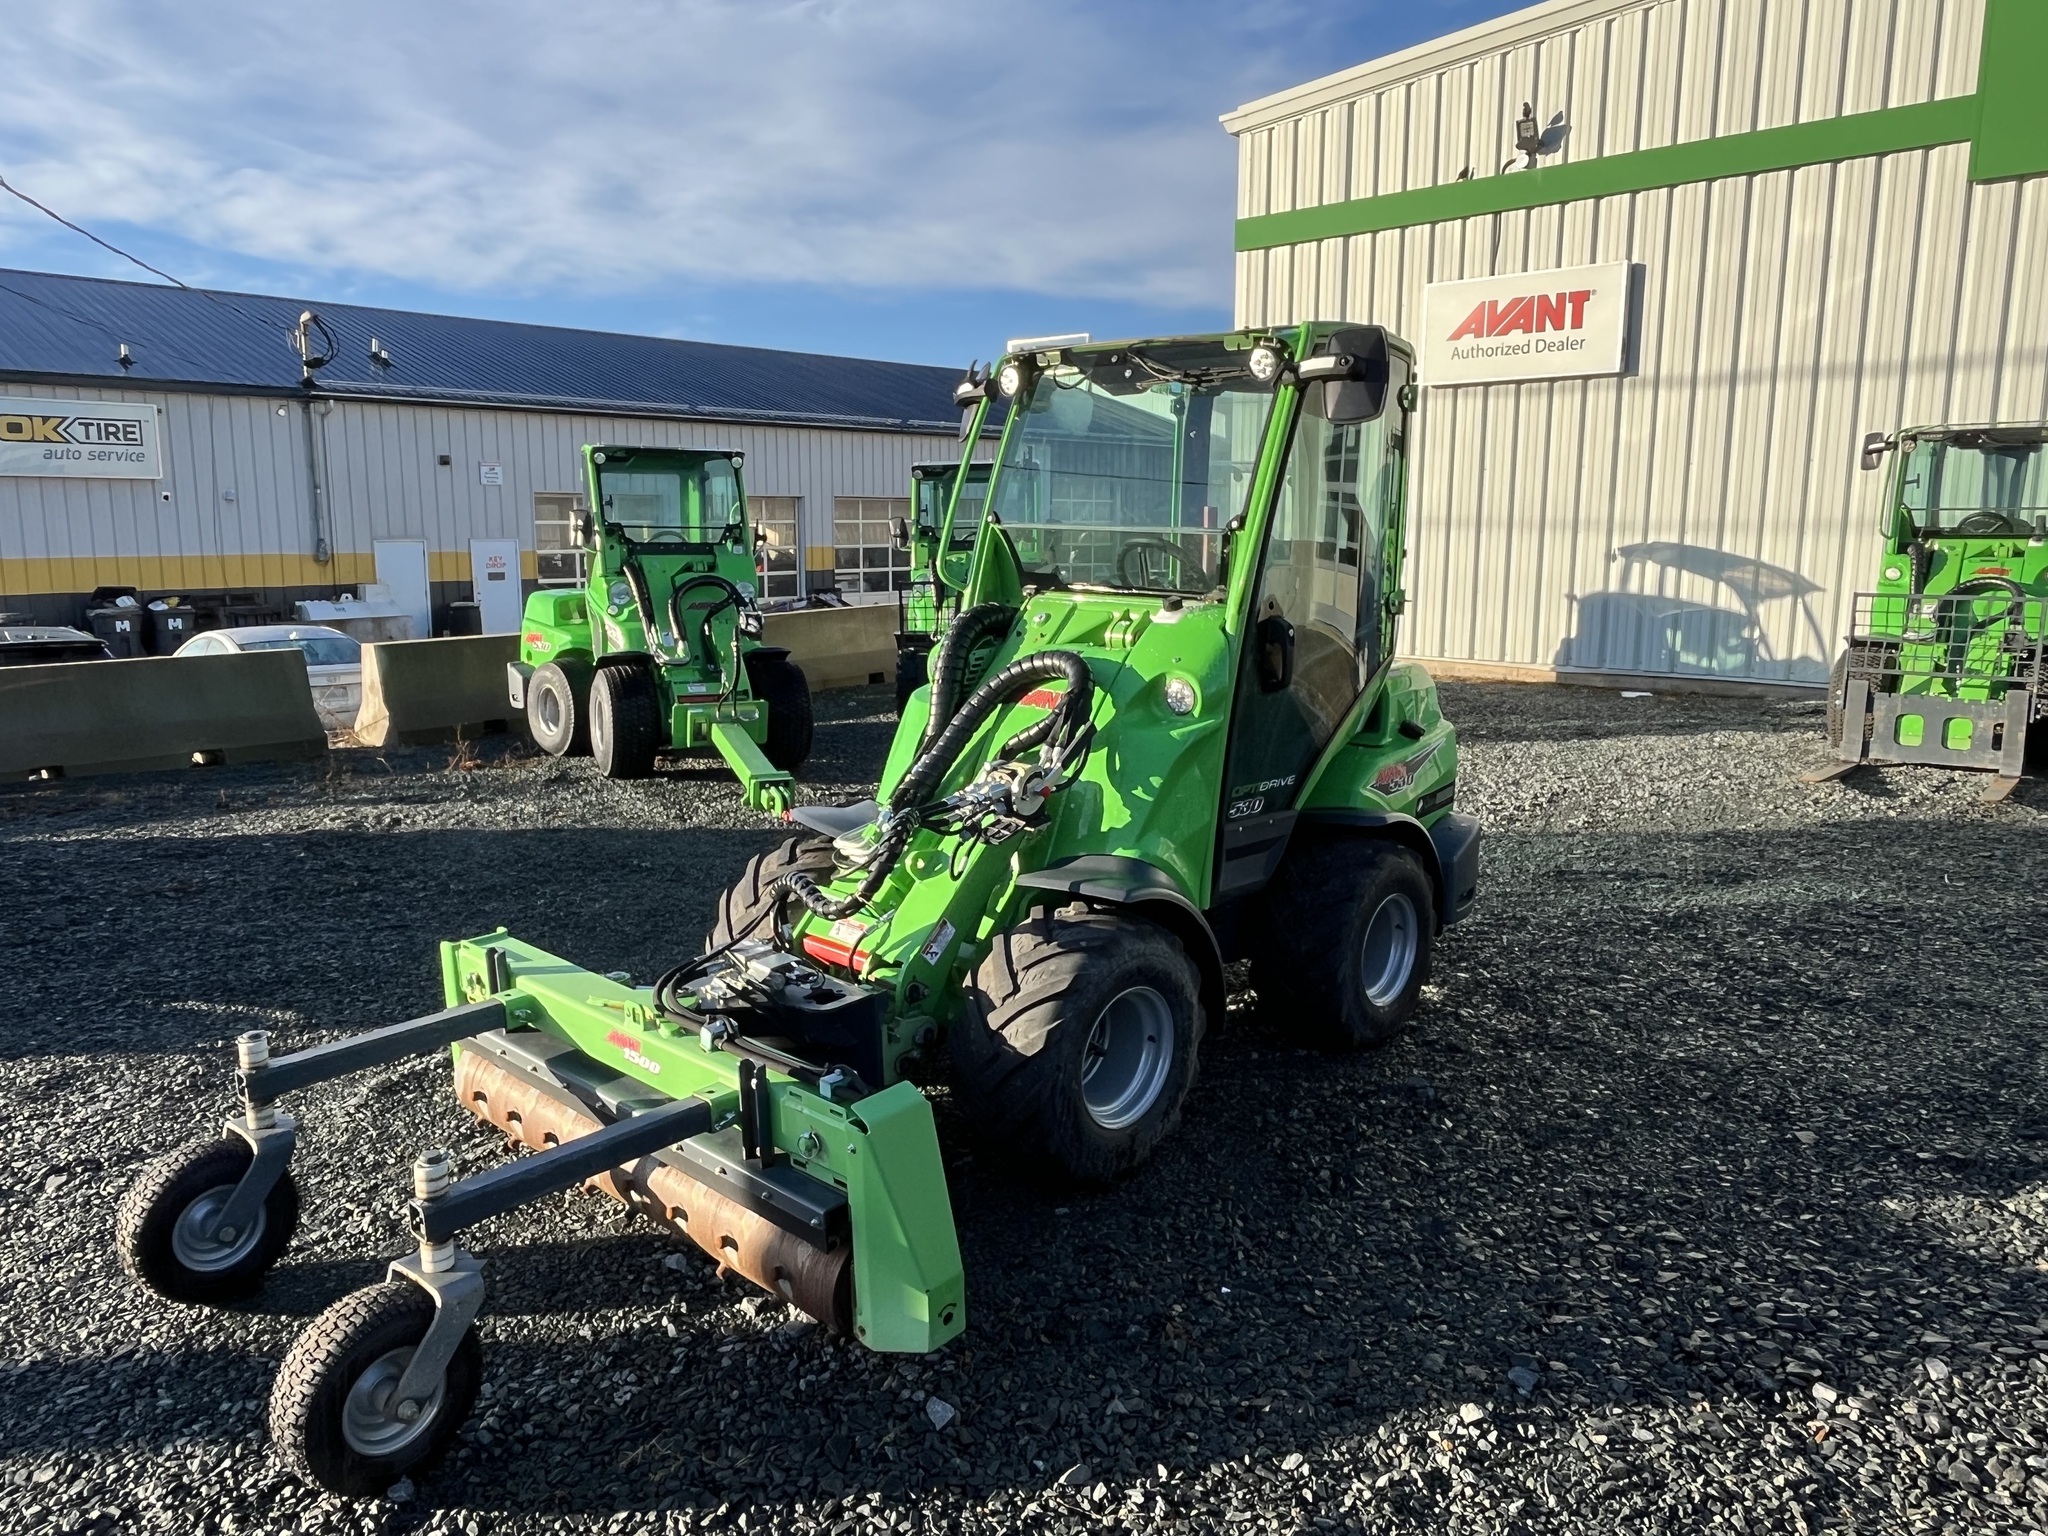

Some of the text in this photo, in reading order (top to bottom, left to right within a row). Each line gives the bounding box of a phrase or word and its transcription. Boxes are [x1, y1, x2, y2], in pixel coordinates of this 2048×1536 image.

[1446, 290, 1591, 341] AVANT
[1451, 336, 1586, 360] Authorized Dealer
[0, 415, 138, 442] OK TIRE
[43, 448, 145, 463] auto service
[1228, 796, 1265, 819] 530
[622, 1047, 661, 1076] 1500
